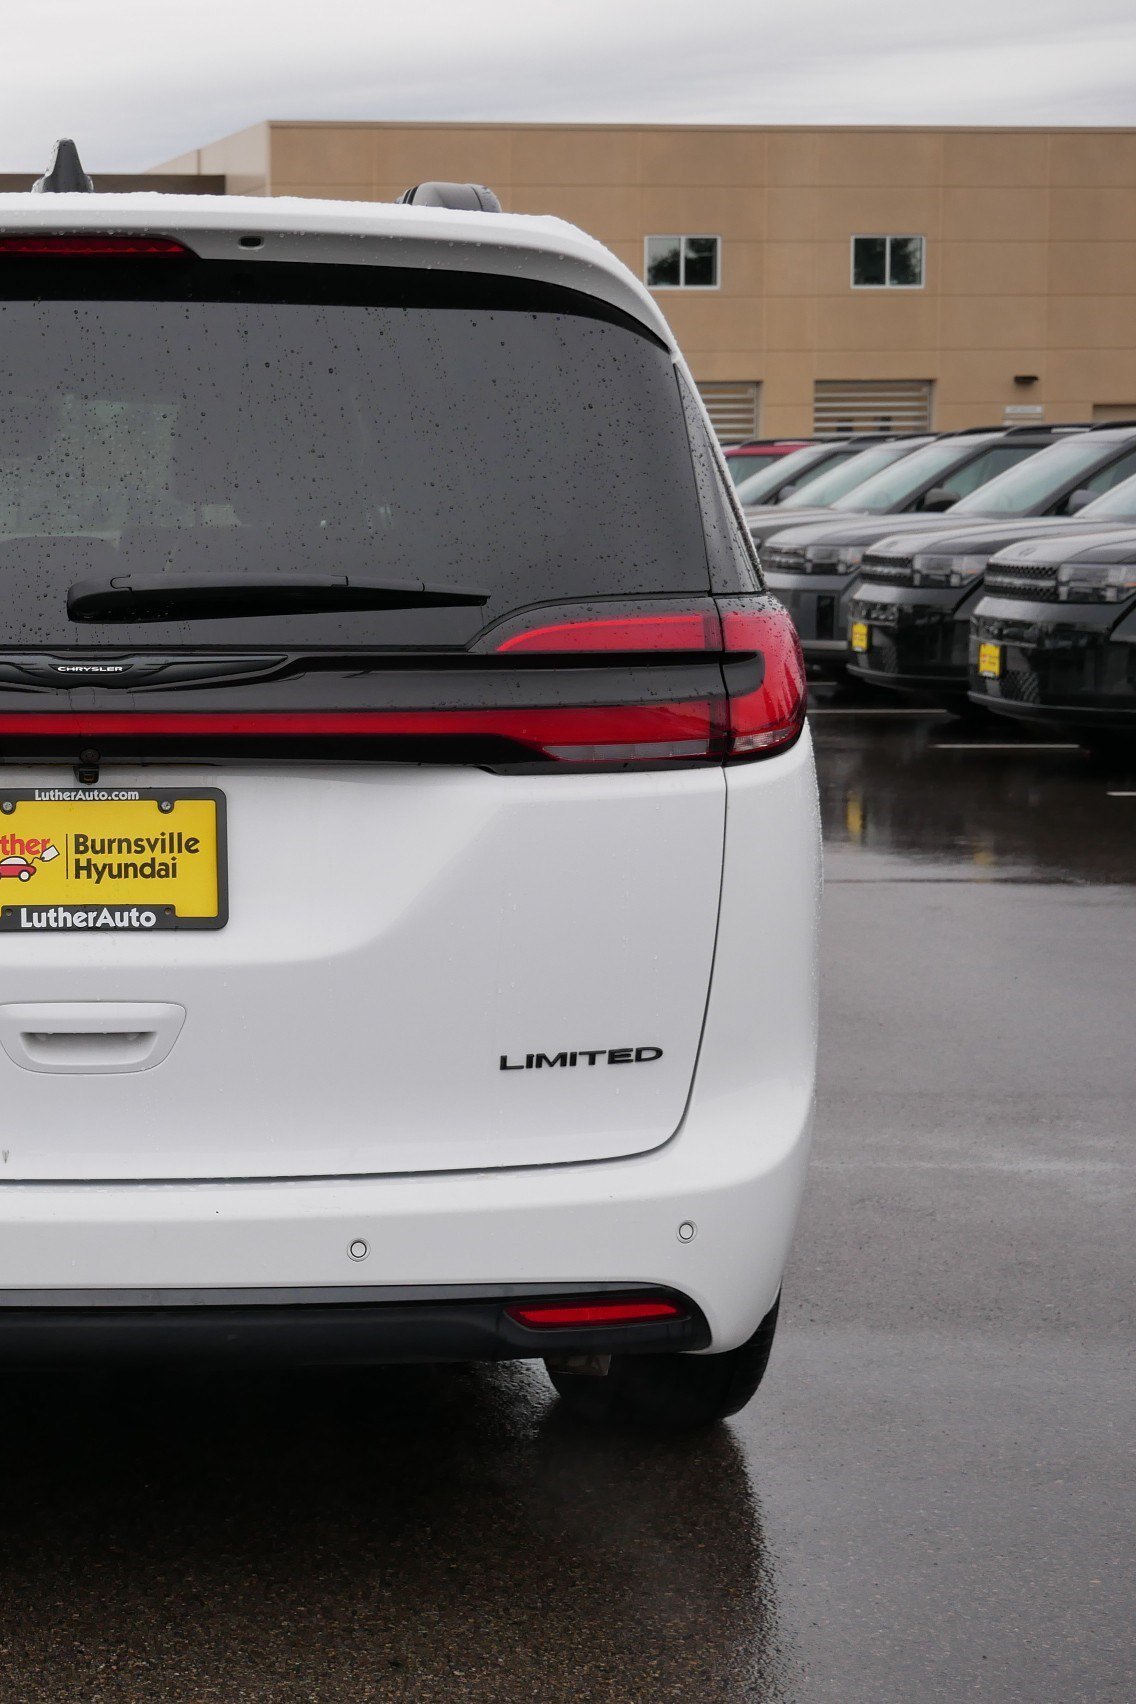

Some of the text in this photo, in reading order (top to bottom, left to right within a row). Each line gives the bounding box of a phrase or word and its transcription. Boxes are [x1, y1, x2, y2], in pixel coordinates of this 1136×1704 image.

[34, 789, 139, 801] LutherAuto.com
[73, 831, 200, 855] Burnsville
[74, 856, 177, 884] Hyundai
[20, 907, 157, 928] LutherAuto
[499, 1046, 664, 1071] LIMITED
